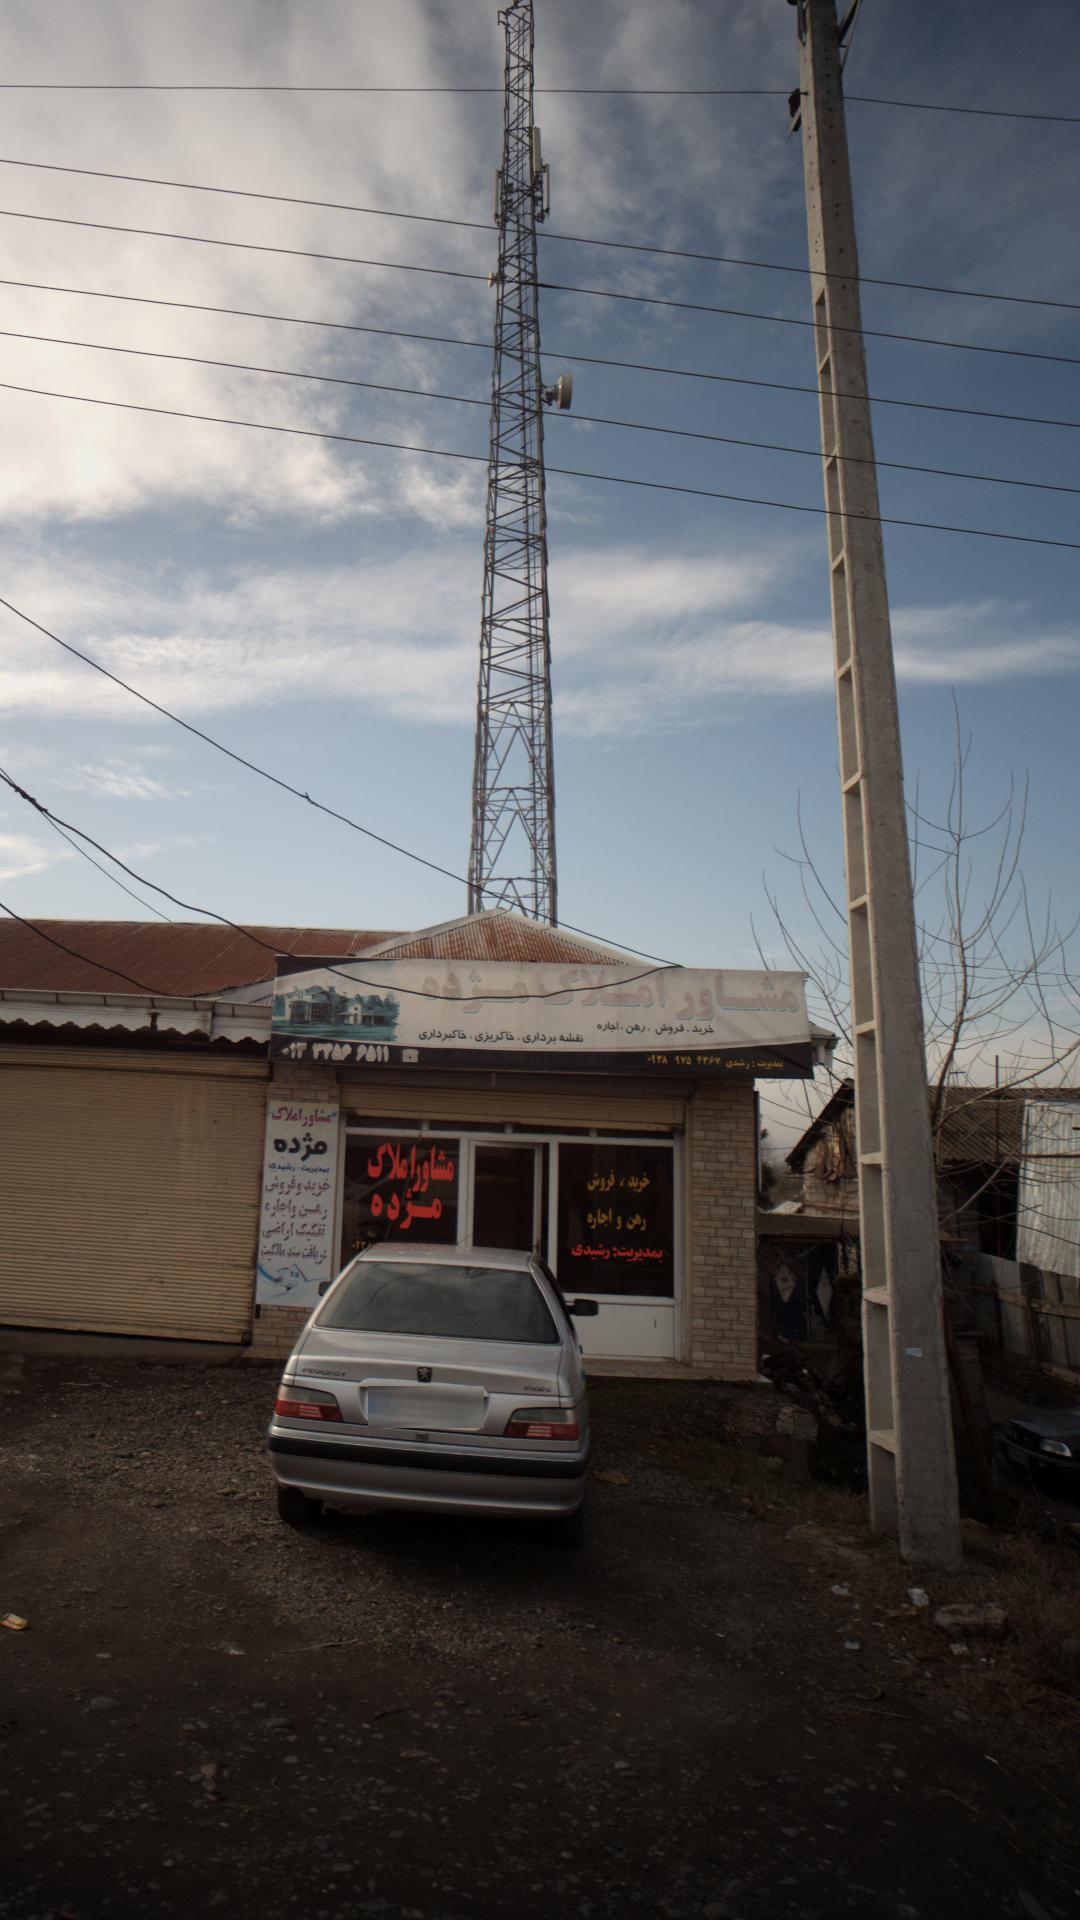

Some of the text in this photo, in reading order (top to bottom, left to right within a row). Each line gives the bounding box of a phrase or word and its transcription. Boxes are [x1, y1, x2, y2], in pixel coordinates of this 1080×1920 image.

[422, 969, 799, 1020] مشاور املاک مژده
[418, 1029, 584, 1044] نقشه برداری خاکریزی خاکبرداری
[597, 1021, 714, 1035] خرید فروش رهن اجاره
[272, 1106, 332, 1127] مشاور املاک
[274, 1132, 328, 1162] مژده
[367, 1142, 454, 1193] مشاور املاک
[587, 1168, 651, 1193] خرید فروش
[370, 1187, 442, 1230] مژده
[586, 1208, 613, 1230] اجاره
[626, 1213, 647, 1231] رهن
[571, 1243, 610, 1260] رشیدی
